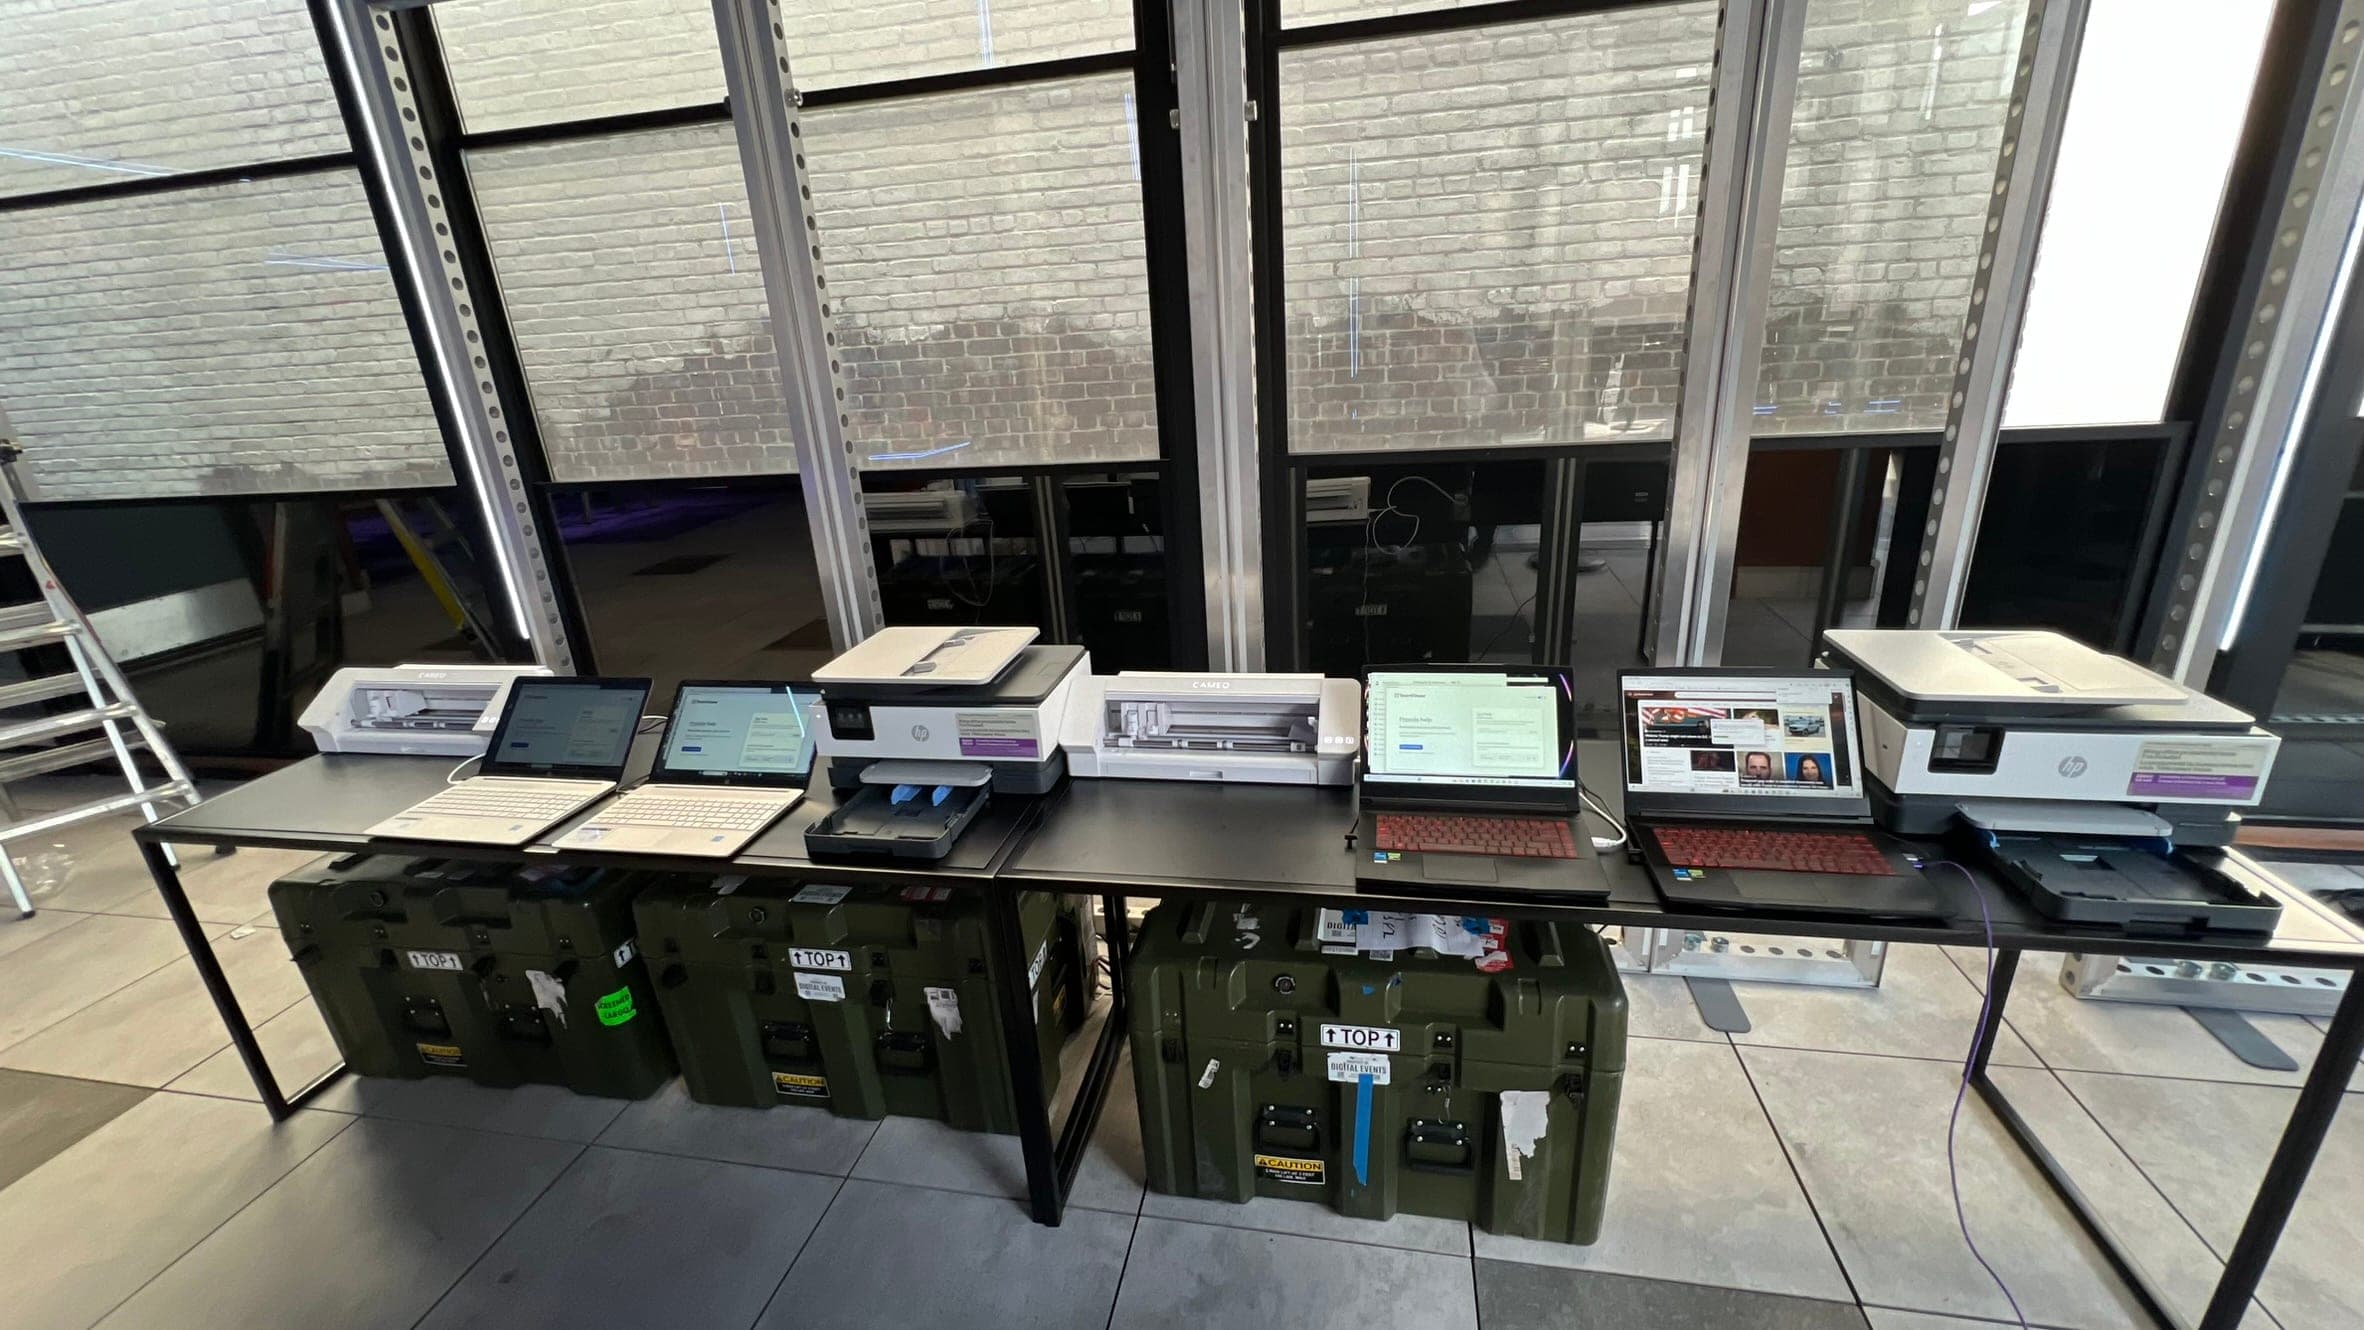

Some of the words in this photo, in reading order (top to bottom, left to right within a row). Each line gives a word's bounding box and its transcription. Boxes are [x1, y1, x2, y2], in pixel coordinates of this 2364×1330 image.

[1192, 681, 1231, 689] CAMEO
[913, 725, 928, 742] hp
[2060, 756, 2086, 778] hp
[1327, 922, 1357, 931] DIGITA
[420, 953, 446, 967] TOP
[804, 951, 835, 966] TOP
[1340, 1029, 1379, 1046] TOP
[1330, 1062, 1358, 1073] DIGITAL
[1360, 1064, 1386, 1074] EVENTS
[1268, 1159, 1321, 1170] CAUTION
